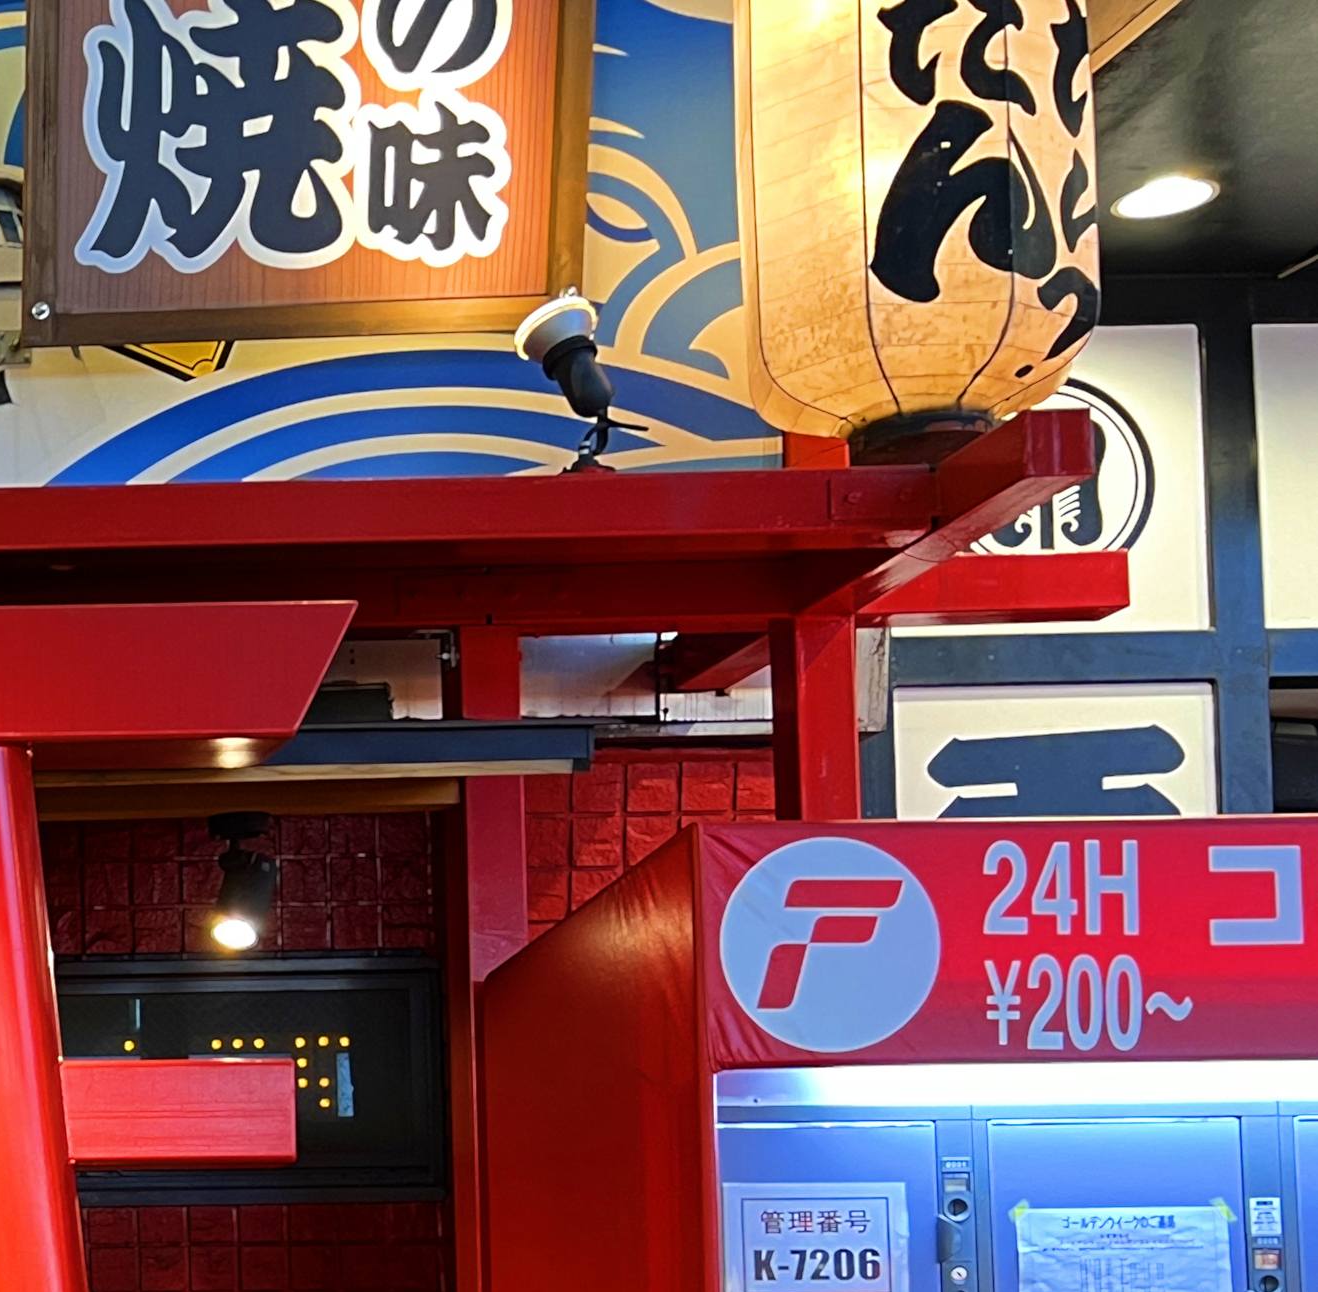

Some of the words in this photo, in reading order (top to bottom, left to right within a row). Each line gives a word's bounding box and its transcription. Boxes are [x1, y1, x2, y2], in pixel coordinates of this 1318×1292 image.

[89, 0, 347, 259] 焼
[982, 839, 1139, 936] 24H
[1208, 846, 1304, 946] コ
[753, 1248, 882, 1283] K-7206
[760, 1208, 872, 1235] 管理番号
